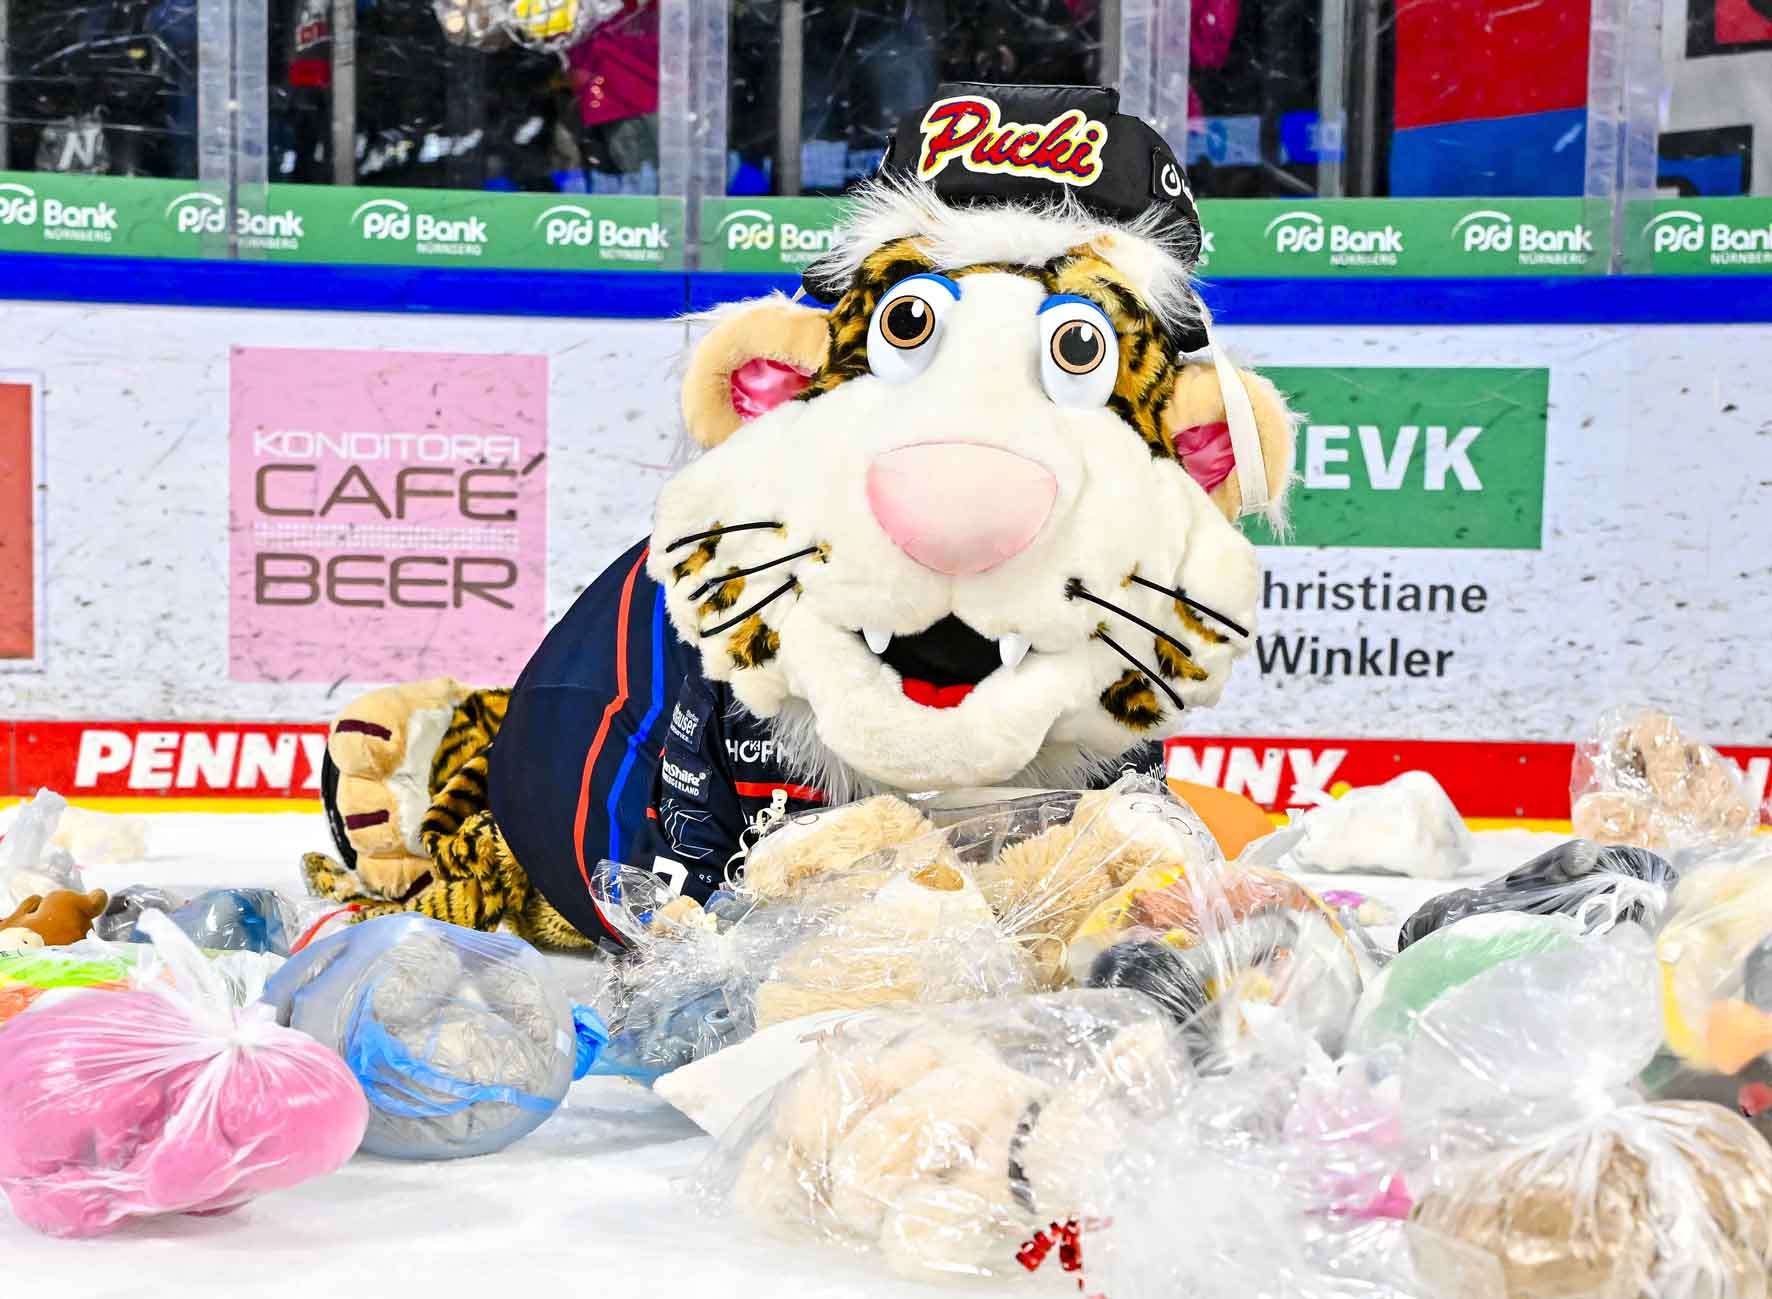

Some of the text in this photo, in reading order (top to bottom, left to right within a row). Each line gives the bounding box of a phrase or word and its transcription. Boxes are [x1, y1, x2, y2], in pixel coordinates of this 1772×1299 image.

[43, 199, 118, 229] Bank
[415, 213, 488, 243] Bank
[598, 219, 669, 248] Bank
[1329, 224, 1403, 253] Bank
[1518, 223, 1593, 252] Bank
[1710, 223, 1772, 251] Ban
[254, 430, 520, 462] KONDITOREI
[1304, 425, 1483, 491] EVK
[256, 452, 546, 522] CAFÉ
[255, 552, 518, 609] BEER
[1262, 570, 1488, 613] hristiane
[1256, 635, 1454, 678] Winkler
[1165, 745, 1348, 806] NNY
